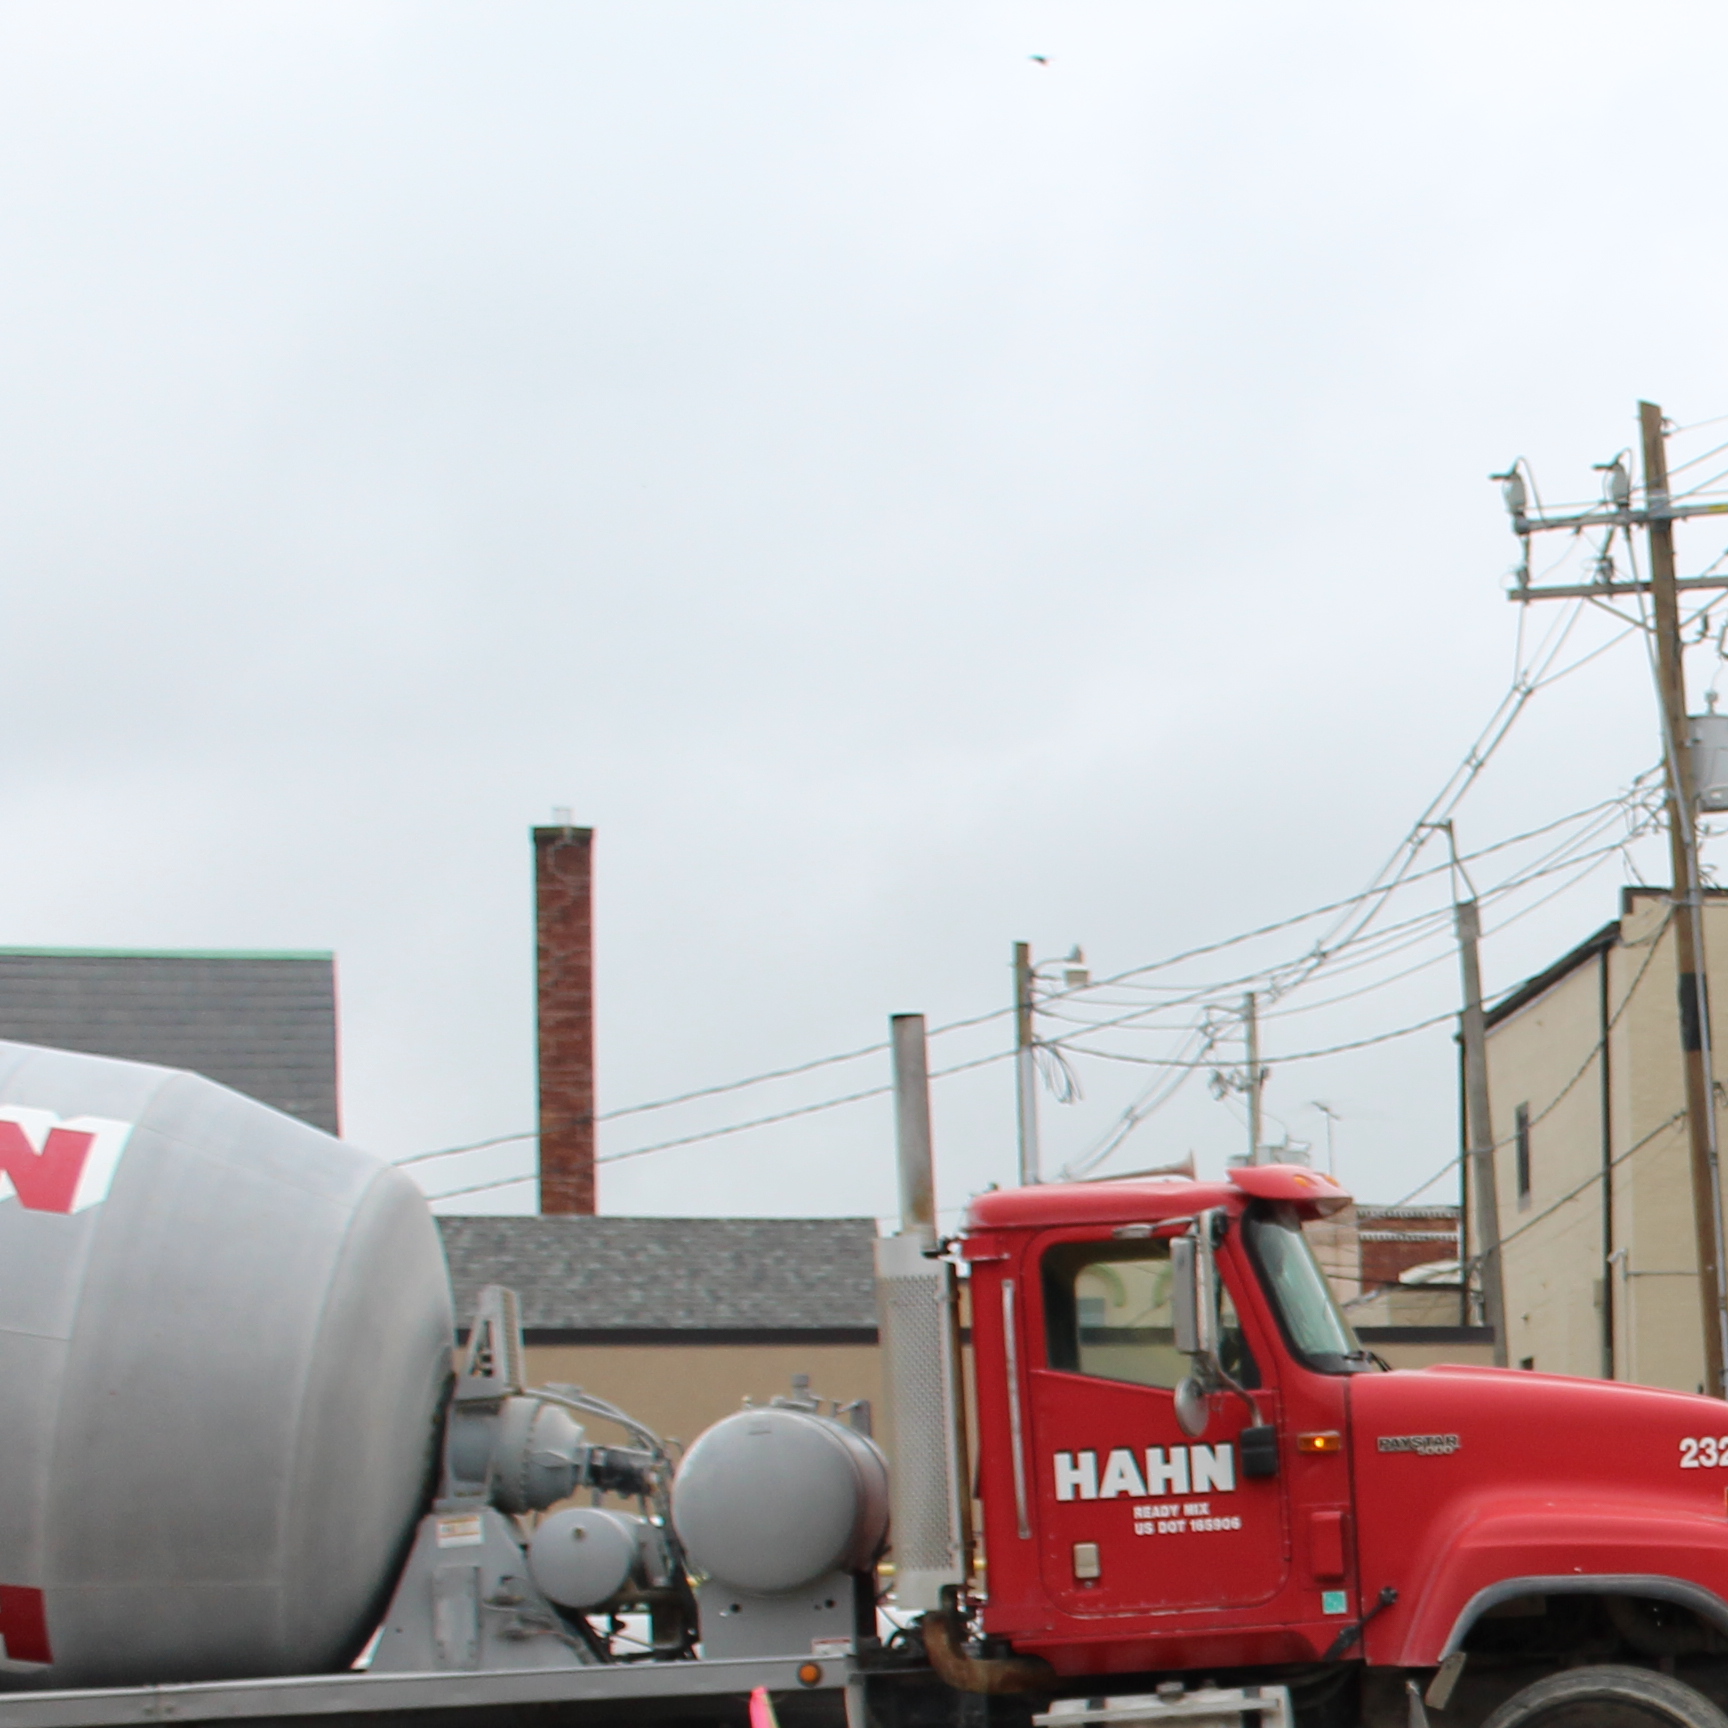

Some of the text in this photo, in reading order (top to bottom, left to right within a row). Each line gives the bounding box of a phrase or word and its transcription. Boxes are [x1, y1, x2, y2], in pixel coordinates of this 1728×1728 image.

[1377, 1434, 1460, 1452] PAYSTAR
[1053, 1442, 1236, 1501] HAHN
[1133, 1502, 1210, 1520] READY MIX
[1134, 1521, 1155, 1536] US
[1157, 1519, 1186, 1534] DOT
